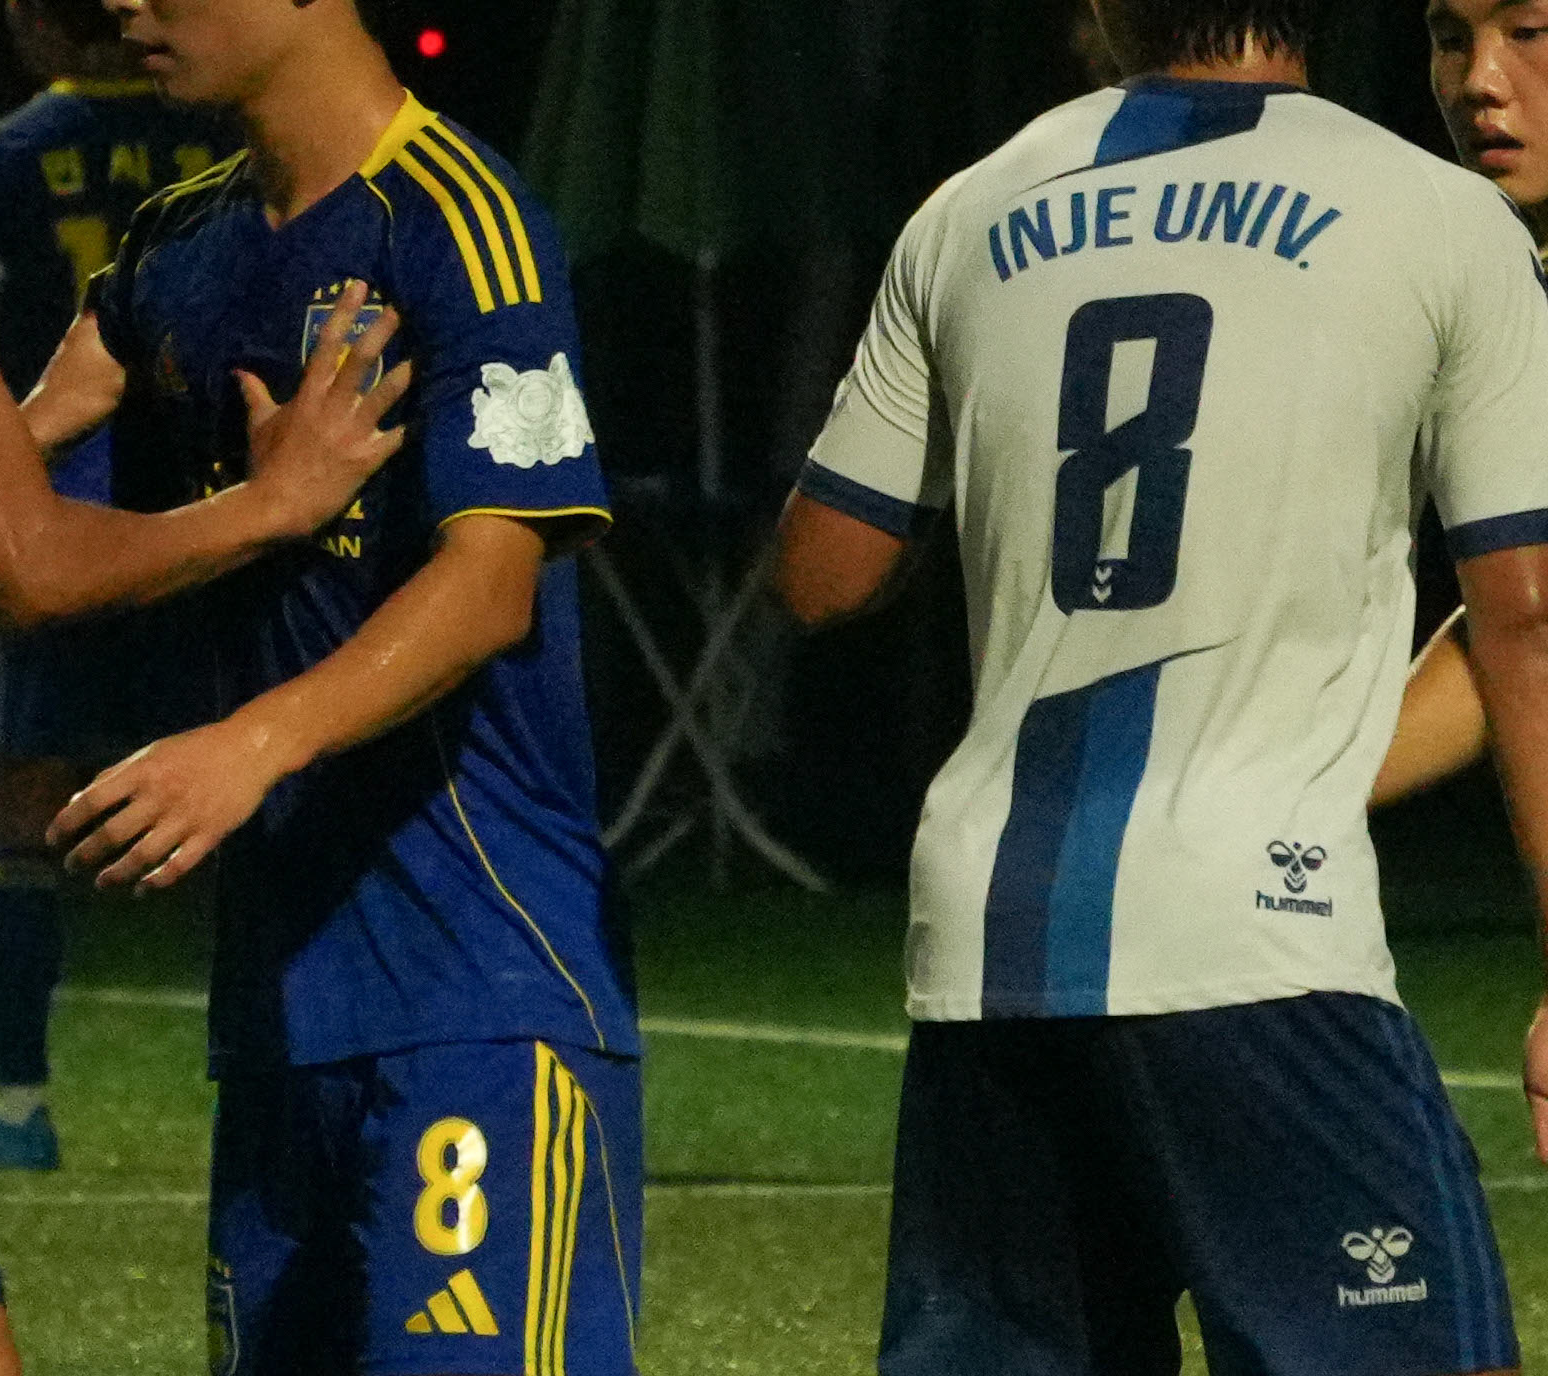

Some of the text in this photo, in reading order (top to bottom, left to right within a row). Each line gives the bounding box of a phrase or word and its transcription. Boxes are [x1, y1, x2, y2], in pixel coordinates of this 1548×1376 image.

[988, 180, 1341, 283] INJE UNIV.
[1051, 293, 1215, 615] 8
[1255, 888, 1333, 918] hummel
[413, 1116, 488, 1256] 8
[1337, 1277, 1429, 1308] hummel
